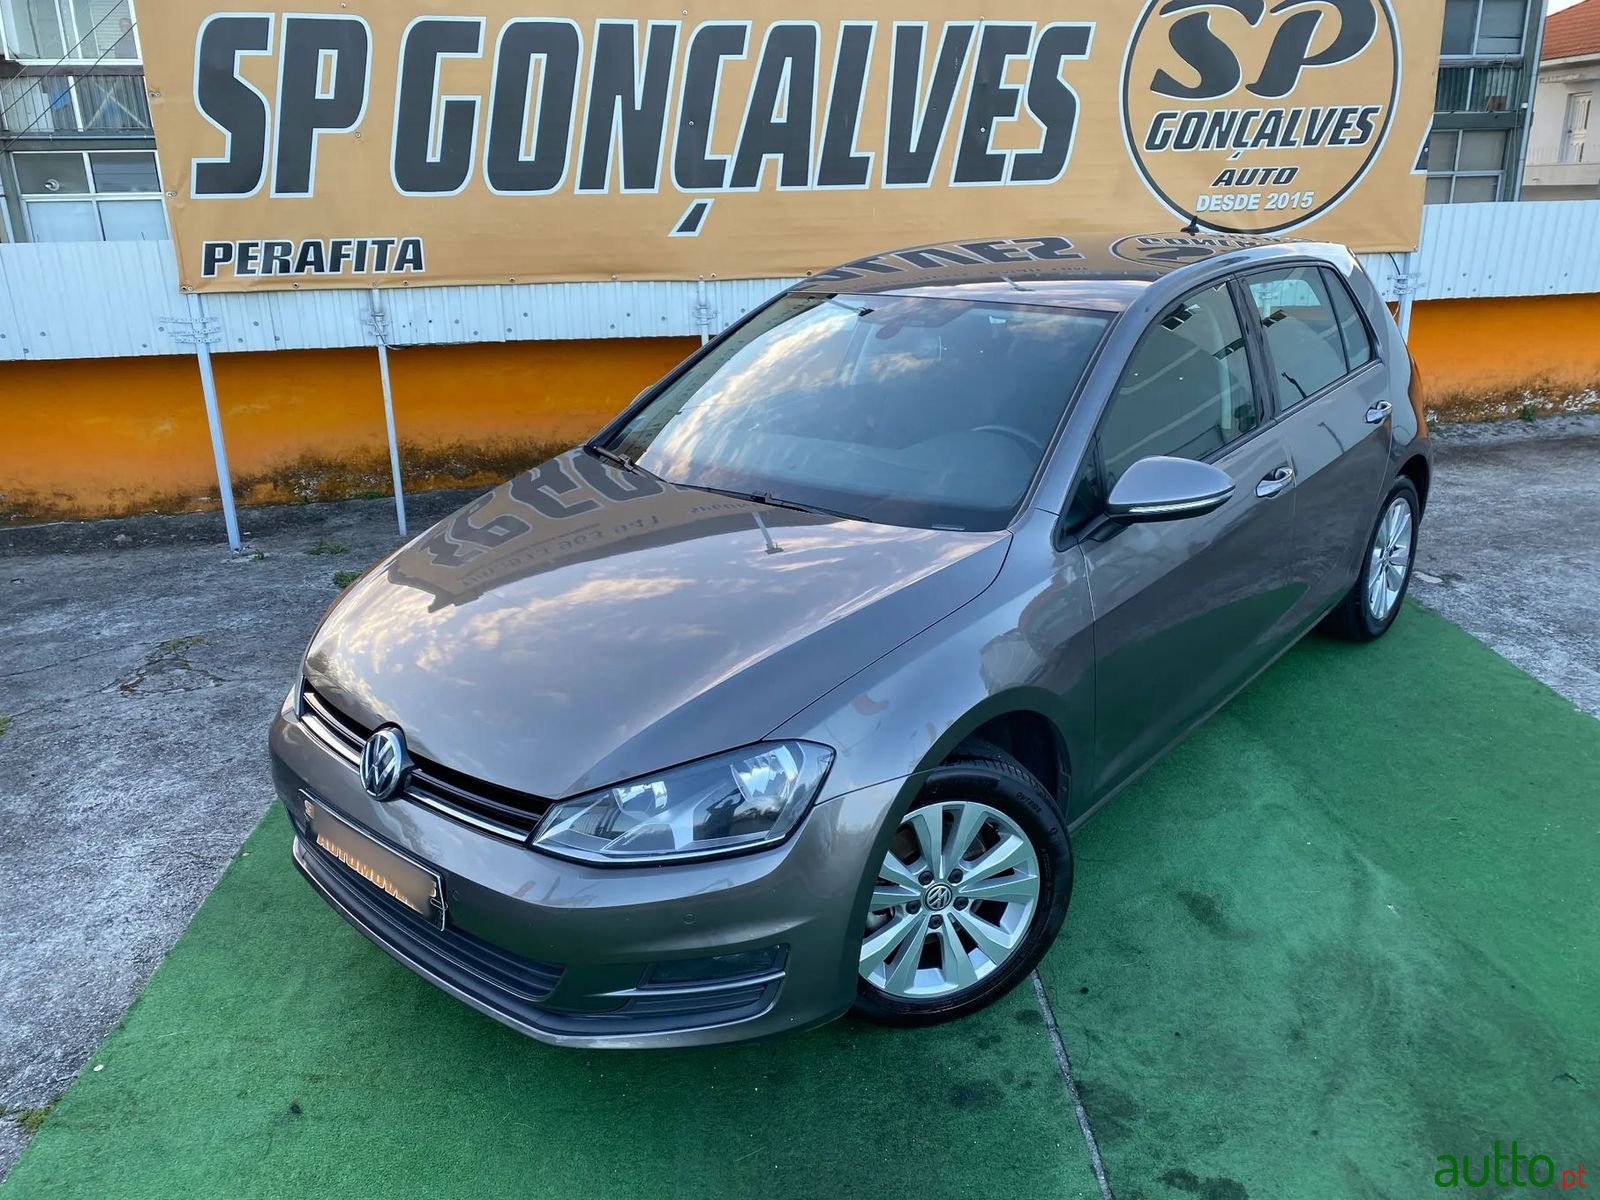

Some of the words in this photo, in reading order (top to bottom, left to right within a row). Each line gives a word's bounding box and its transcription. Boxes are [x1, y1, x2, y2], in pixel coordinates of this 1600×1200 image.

[1149, 0, 1377, 99] SP
[190, 12, 373, 198] SP
[389, 15, 1096, 237] GONÇALVES
[1144, 104, 1382, 161] GONÇALVES
[1195, 193, 1262, 212] DESDE
[1264, 191, 1315, 210] 2015
[1210, 166, 1300, 188] AUTO
[200, 236, 426, 279] PERAFITA
